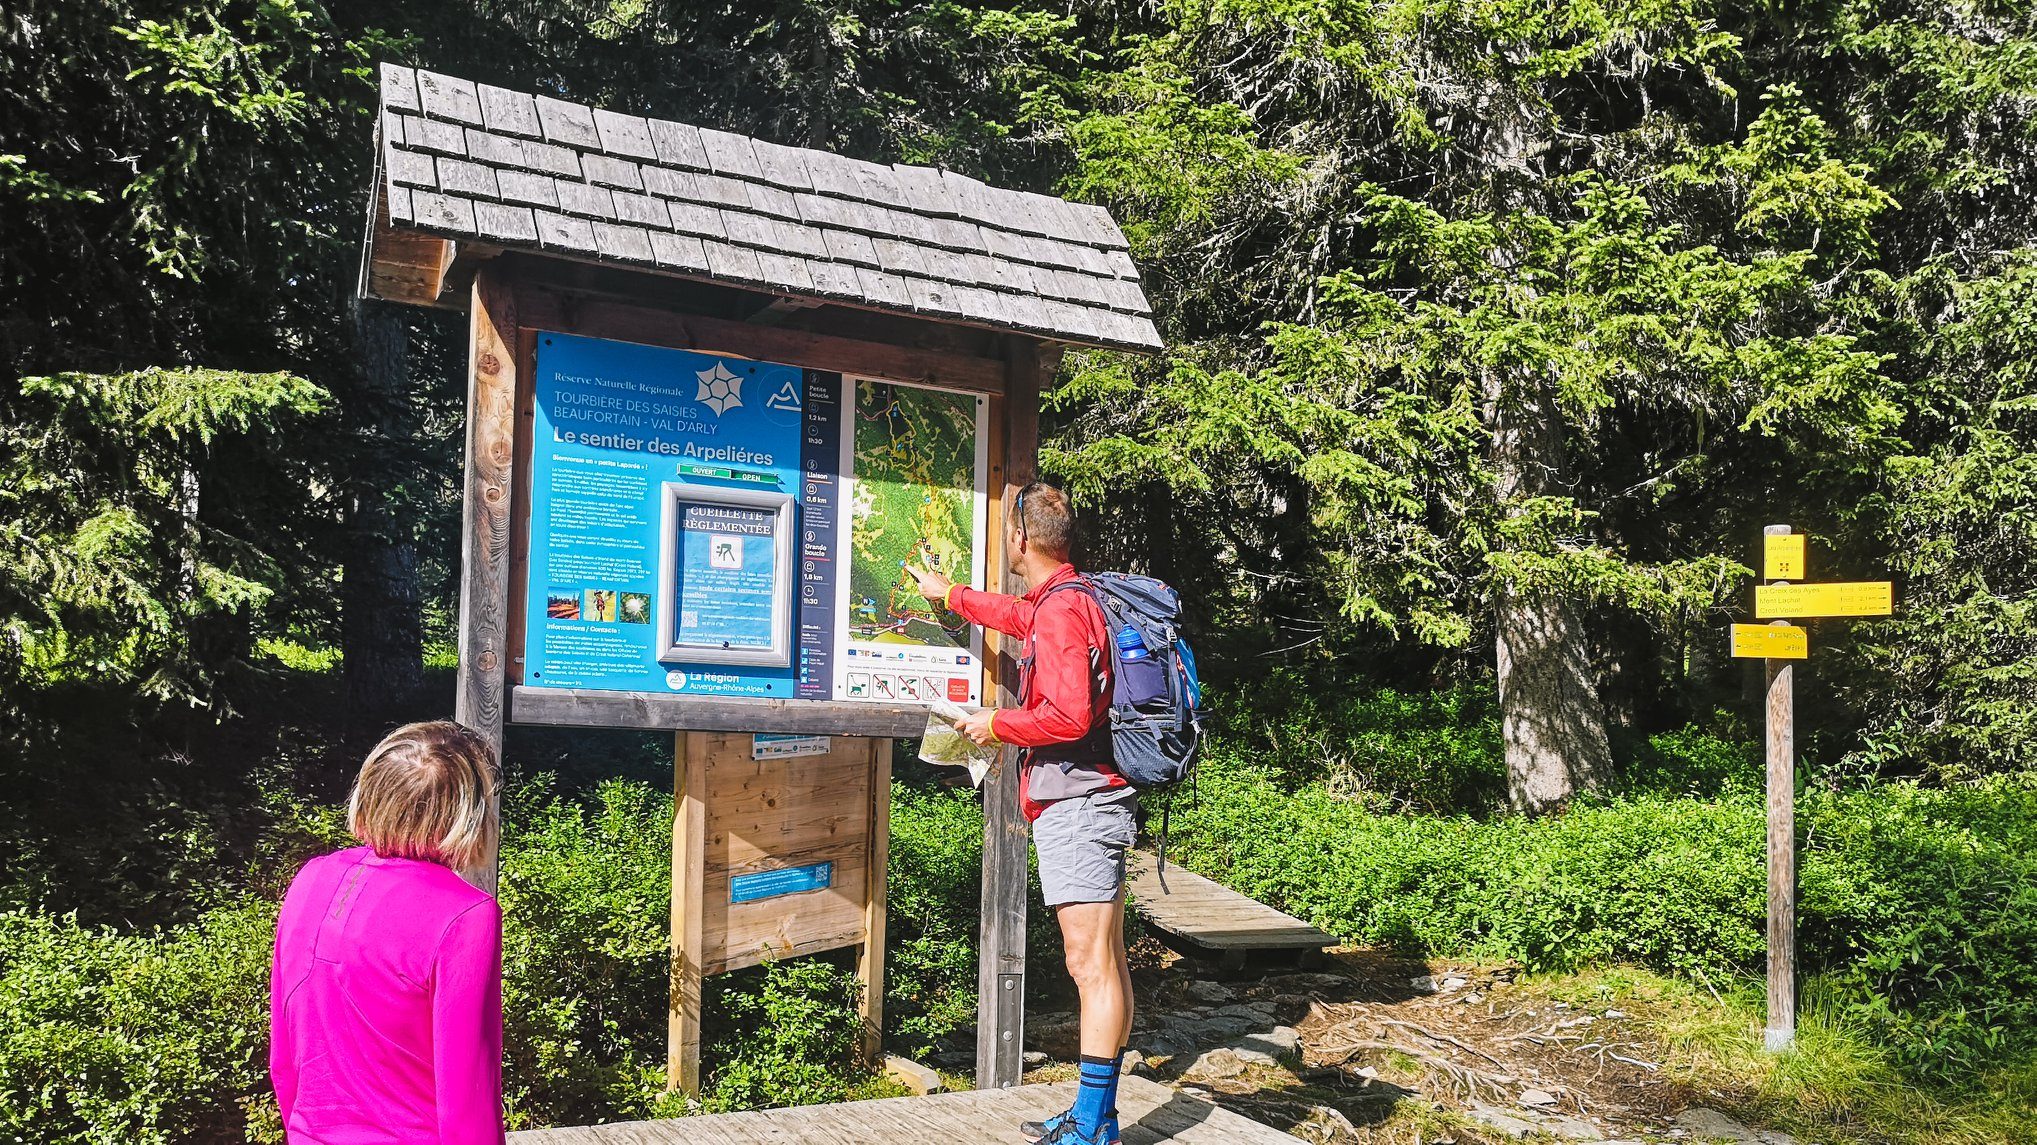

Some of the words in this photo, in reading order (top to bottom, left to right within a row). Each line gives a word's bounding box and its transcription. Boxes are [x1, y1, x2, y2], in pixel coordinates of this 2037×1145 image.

[554, 371, 592, 386] Réserve
[595, 377, 637, 391] Naturelle
[638, 383, 684, 397] Régionale
[809, 385, 827, 393] Petite
[808, 391, 829, 400] boucle
[554, 390, 623, 410] TOURBIÈRE
[626, 399, 650, 413] DES
[652, 402, 697, 419] SAISIES
[554, 407, 641, 428] BEAUFORTAIN
[651, 418, 674, 432] VAL
[677, 420, 718, 436] D'ARLY
[553, 426, 576, 444] Le
[579, 432, 644, 452] sentier
[647, 436, 680, 456] des
[692, 466, 717, 476] OUVERT
[807, 471, 828, 480] Liaison
[742, 473, 761, 482] OPEN
[817, 496, 827, 504] km
[690, 506, 764, 521] CUEILLETTE
[804, 543, 827, 551] Grande
[804, 549, 826, 557] boucle
[813, 574, 823, 582] km
[546, 622, 586, 633] Informations
[690, 672, 702, 681] La
[704, 672, 740, 684] Région
[689, 682, 765, 693] Auvergne-Rhône-Alpes
